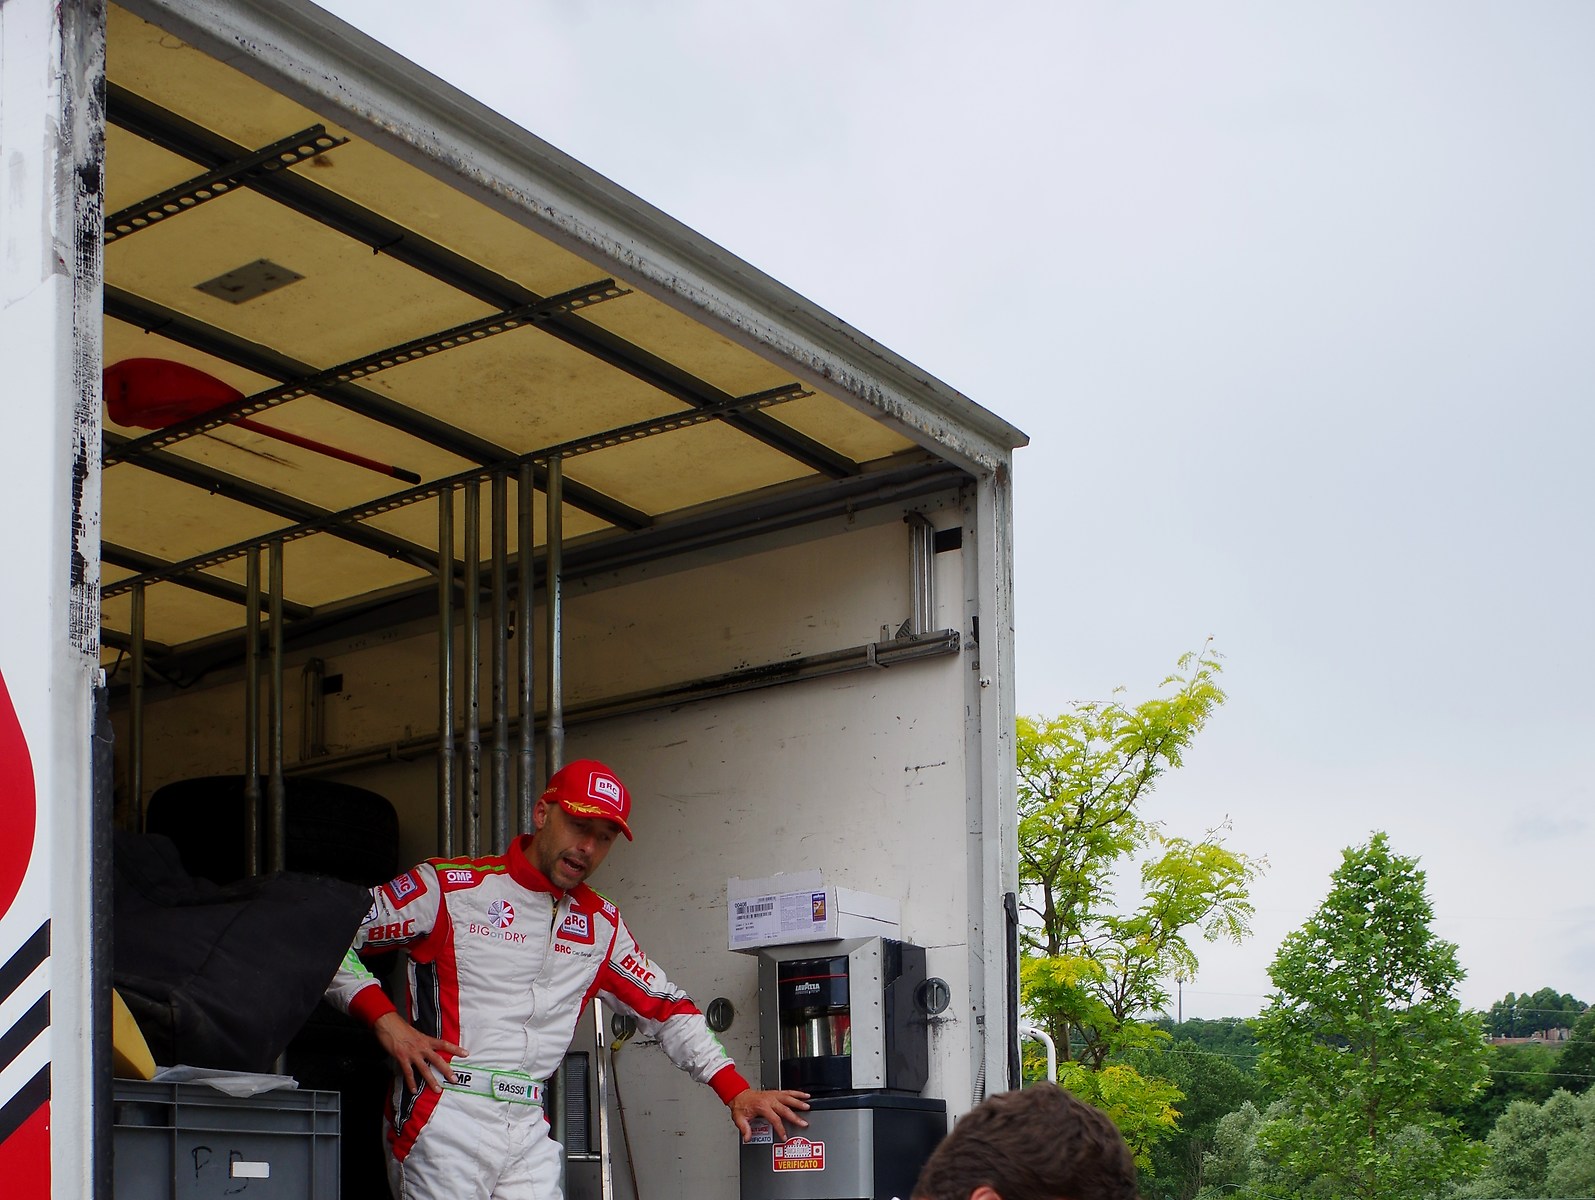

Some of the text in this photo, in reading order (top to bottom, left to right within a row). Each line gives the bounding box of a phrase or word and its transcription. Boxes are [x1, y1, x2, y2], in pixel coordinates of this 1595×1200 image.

[599, 781, 618, 795] BRC
[446, 872, 472, 882] OMP
[564, 914, 586, 929] BRC
[367, 918, 416, 941] BRC
[554, 943, 572, 955] BRC
[620, 953, 656, 987] BRC
[498, 1082, 525, 1096] BASSO
[778, 1160, 818, 1169] VERIFICATO
